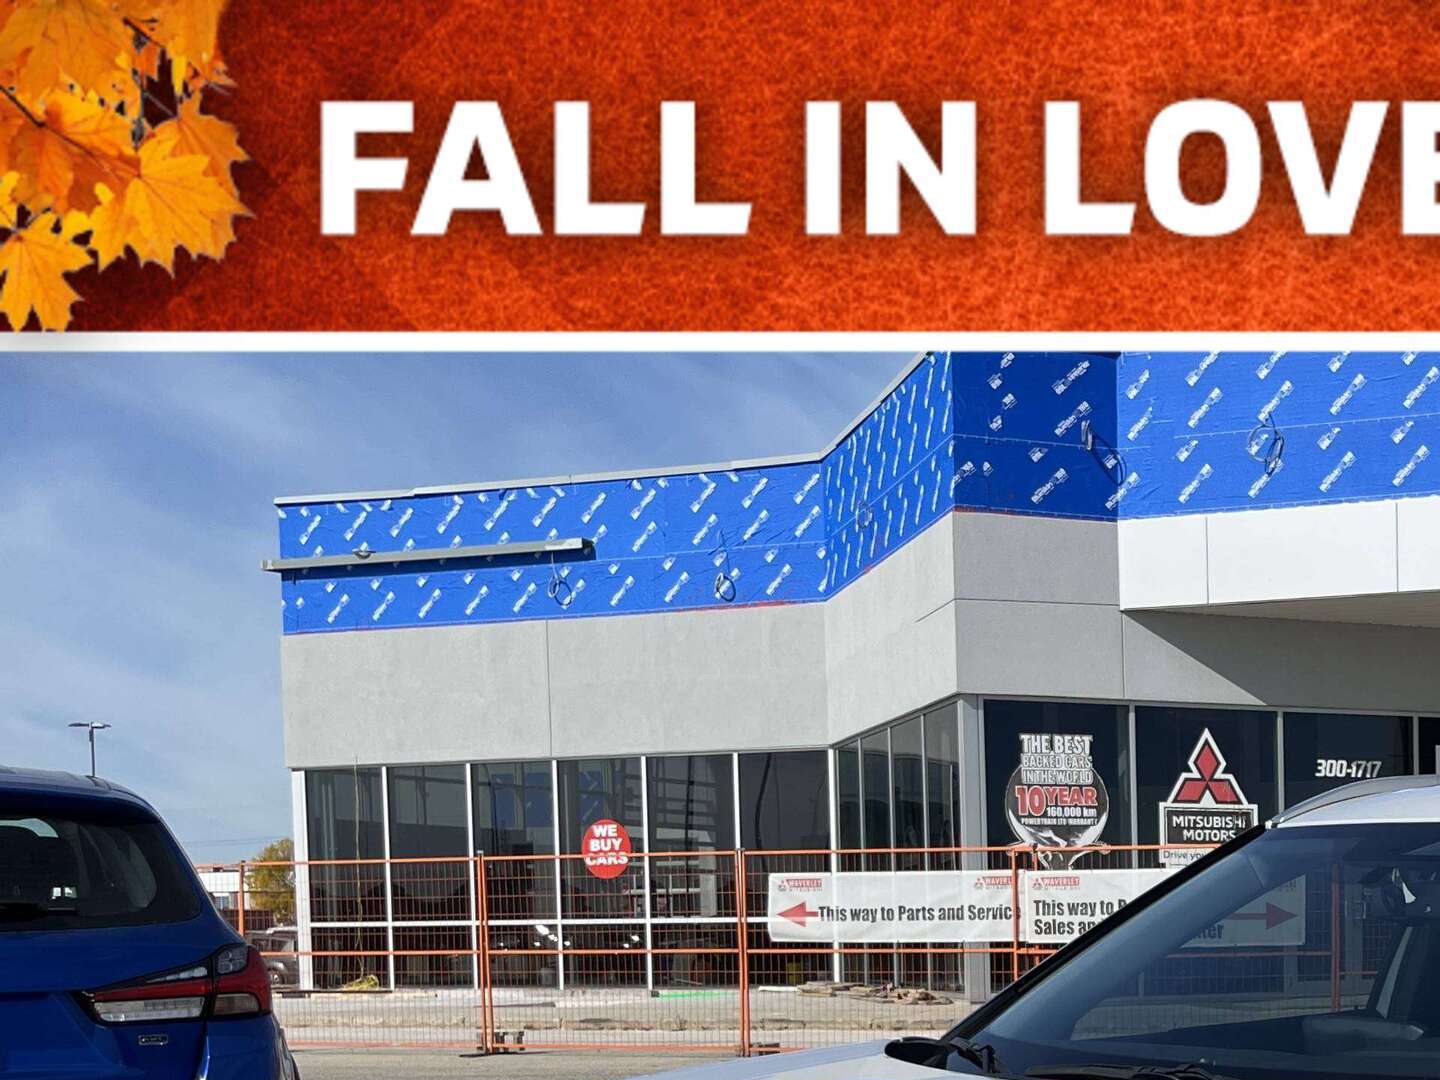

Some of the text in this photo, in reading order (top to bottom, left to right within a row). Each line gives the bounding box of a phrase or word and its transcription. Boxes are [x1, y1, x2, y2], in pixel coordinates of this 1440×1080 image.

[1019, 734, 1093, 754] THE BEST
[1022, 754, 1062, 769] BACKED
[1315, 759, 1382, 778] 300-1717
[1022, 769, 1093, 784] IN THE WORLD
[1015, 785, 1098, 816] 10 YEAR
[1047, 807, 1097, 817] 160,000 km
[1172, 815, 1246, 828] MITSUBISHI
[592, 824, 618, 838] WE
[1183, 829, 1237, 842] MOTORS
[590, 838, 622, 852] BUY
[584, 851, 629, 866] CARS
[1163, 850, 1188, 860] Drive
[818, 906, 847, 921] This
[850, 907, 877, 923] way
[881, 907, 894, 921] to
[898, 905, 934, 921] Parts
[938, 905, 963, 920] and
[1034, 900, 1065, 916] This
[1067, 902, 1097, 917] way
[1100, 900, 1115, 916] to
[1035, 919, 1075, 935] Sales
